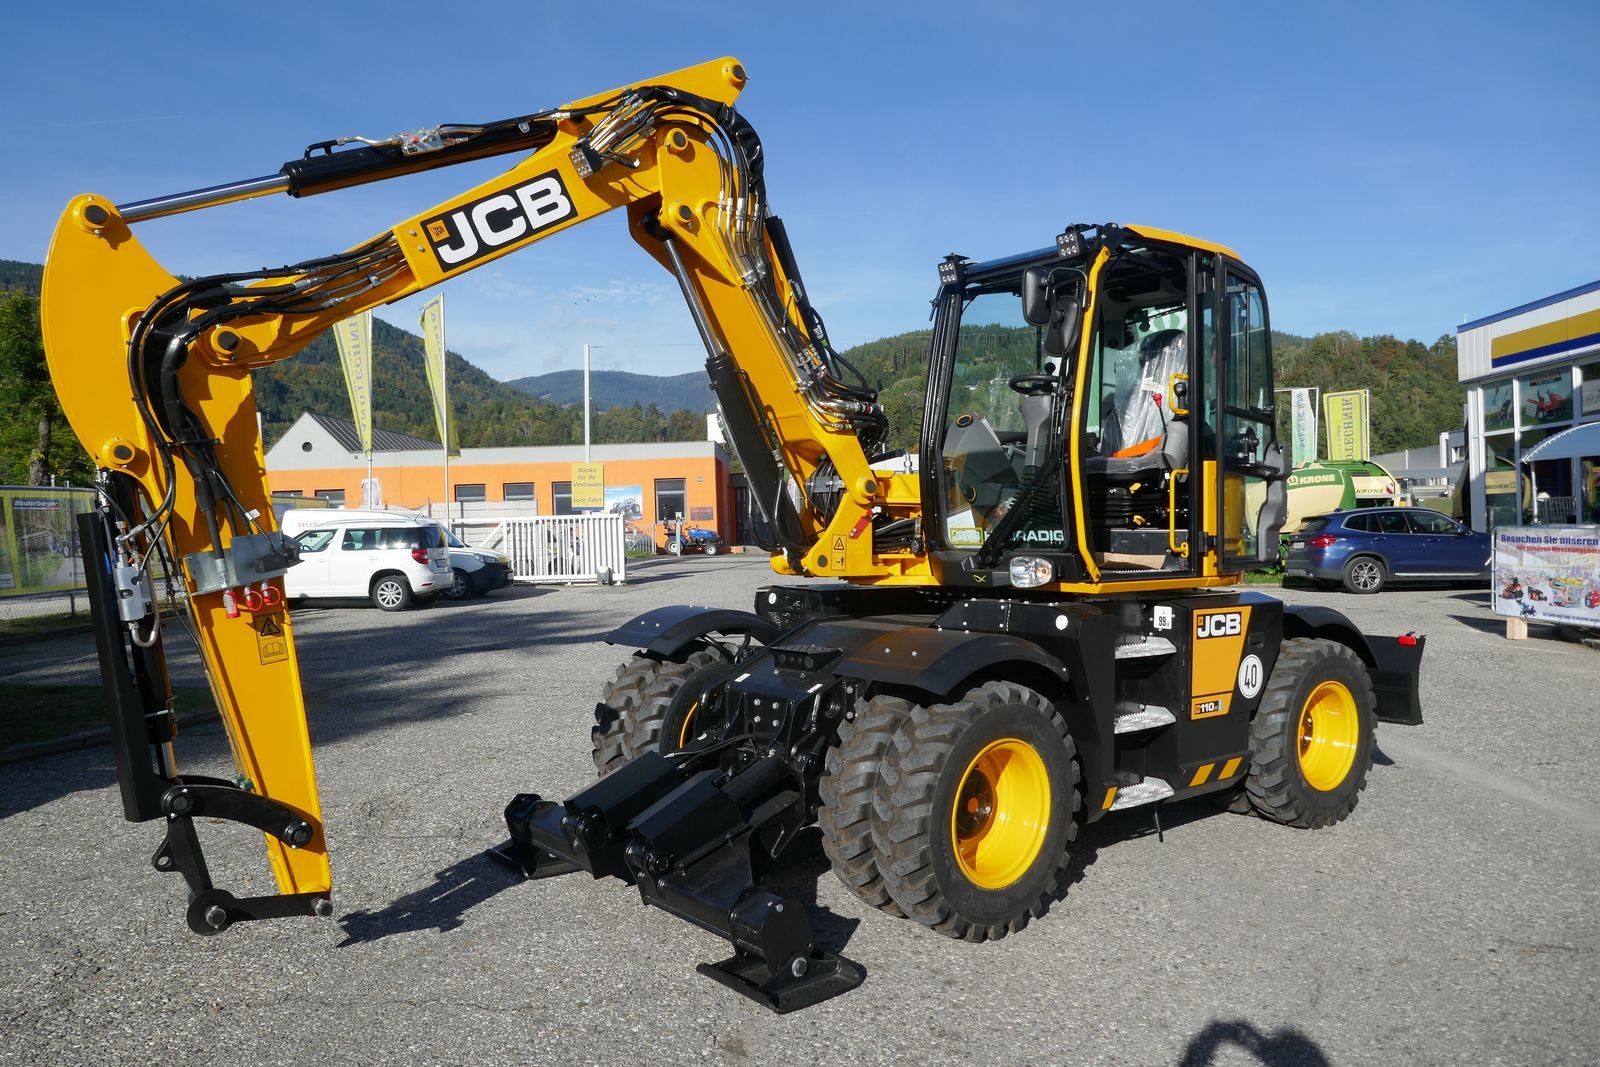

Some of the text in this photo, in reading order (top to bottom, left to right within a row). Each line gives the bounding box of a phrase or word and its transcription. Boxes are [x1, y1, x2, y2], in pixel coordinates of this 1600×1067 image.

[437, 177, 571, 264] JCB
[1300, 474, 1335, 484] KRONE
[1501, 534, 1599, 546] Besuchen Sie unseren
[1159, 616, 1166, 626] 99
[1197, 614, 1240, 637] JCB
[1244, 664, 1257, 689] 40
